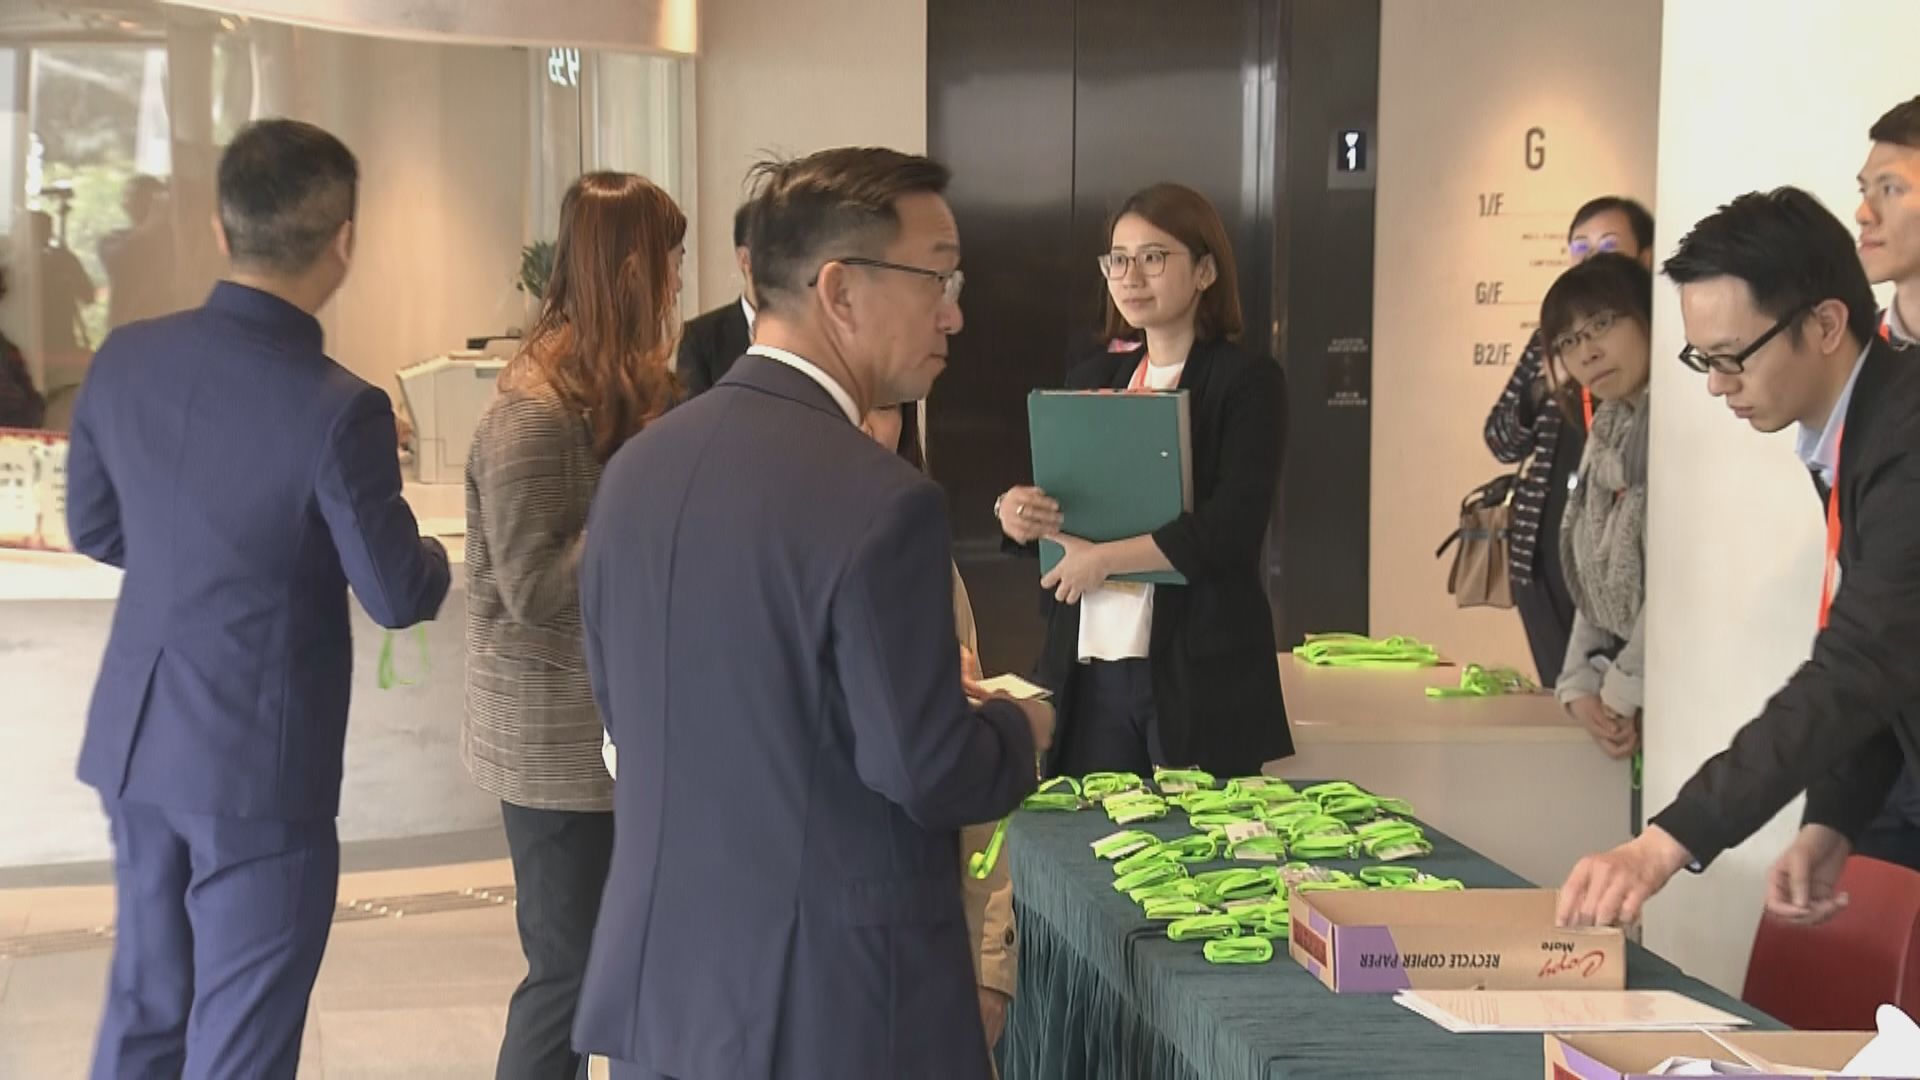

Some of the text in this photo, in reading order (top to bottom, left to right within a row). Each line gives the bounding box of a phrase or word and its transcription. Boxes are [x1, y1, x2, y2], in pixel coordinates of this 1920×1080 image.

[1346, 147, 1357, 170] 1
[1525, 127, 1545, 170] G
[1479, 193, 1504, 217] 1/F
[1475, 282, 1504, 304] G/F
[1473, 343, 1512, 367] B2/F
[1541, 942, 1575, 952] Mate
[1360, 953, 1500, 969] RECYCLE COPIER PAPER
[1538, 950, 1605, 978] Copy
